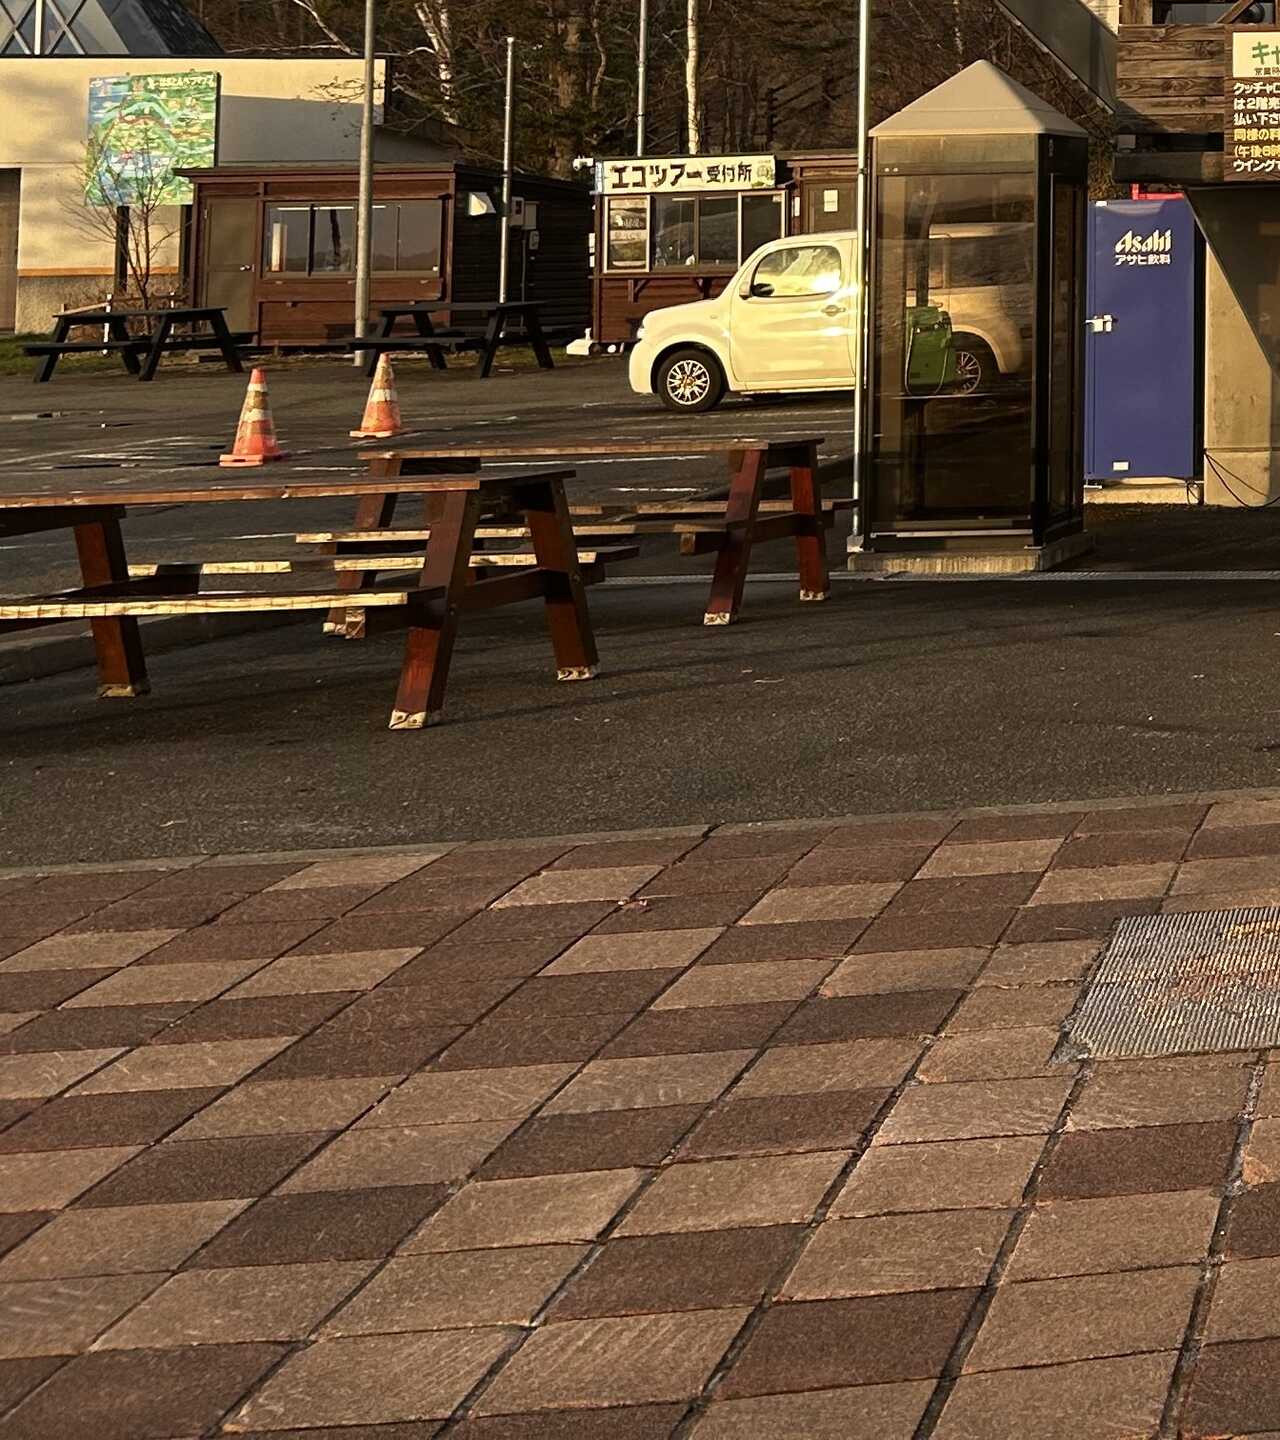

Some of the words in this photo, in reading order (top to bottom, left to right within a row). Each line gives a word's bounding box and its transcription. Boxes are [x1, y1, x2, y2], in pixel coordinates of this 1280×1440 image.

[611, 163, 703, 189] エコツアー
[706, 161, 753, 184] 受付所
[1115, 229, 1171, 253] Asahi
[1115, 254, 1171, 266] アサヒ飲料
